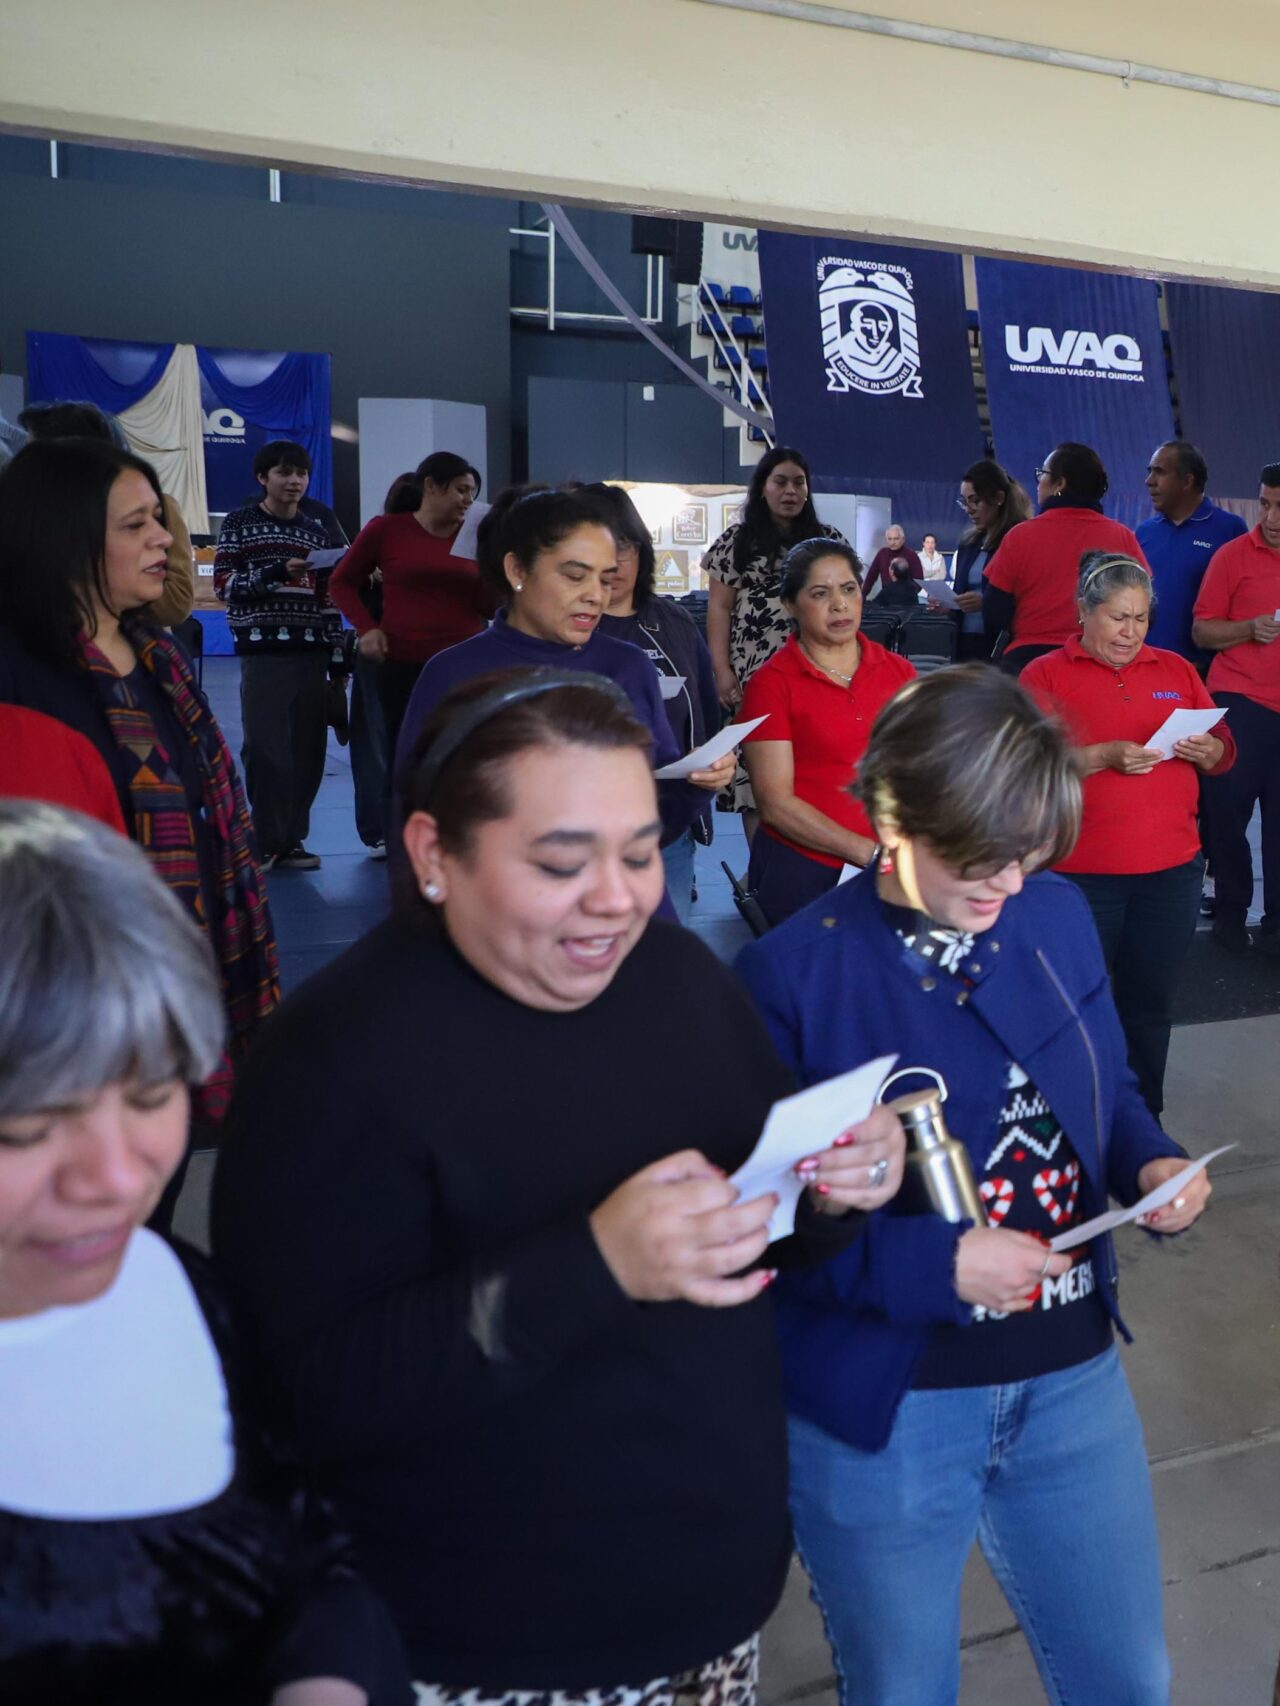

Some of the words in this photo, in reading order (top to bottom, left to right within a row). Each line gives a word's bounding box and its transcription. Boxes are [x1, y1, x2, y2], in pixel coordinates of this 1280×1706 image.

[817, 256, 853, 280] UNIVERSIDAD
[853, 260, 877, 270] VASCO
[878, 263, 888, 271] DE
[1005, 324, 1143, 371] UVAQ
[836, 360, 869, 389] EDUCERE
[1010, 363, 1066, 375] UNIVERSIDAD
[1067, 368, 1095, 378] VASCO
[1108, 371, 1145, 382] QUIROGA
